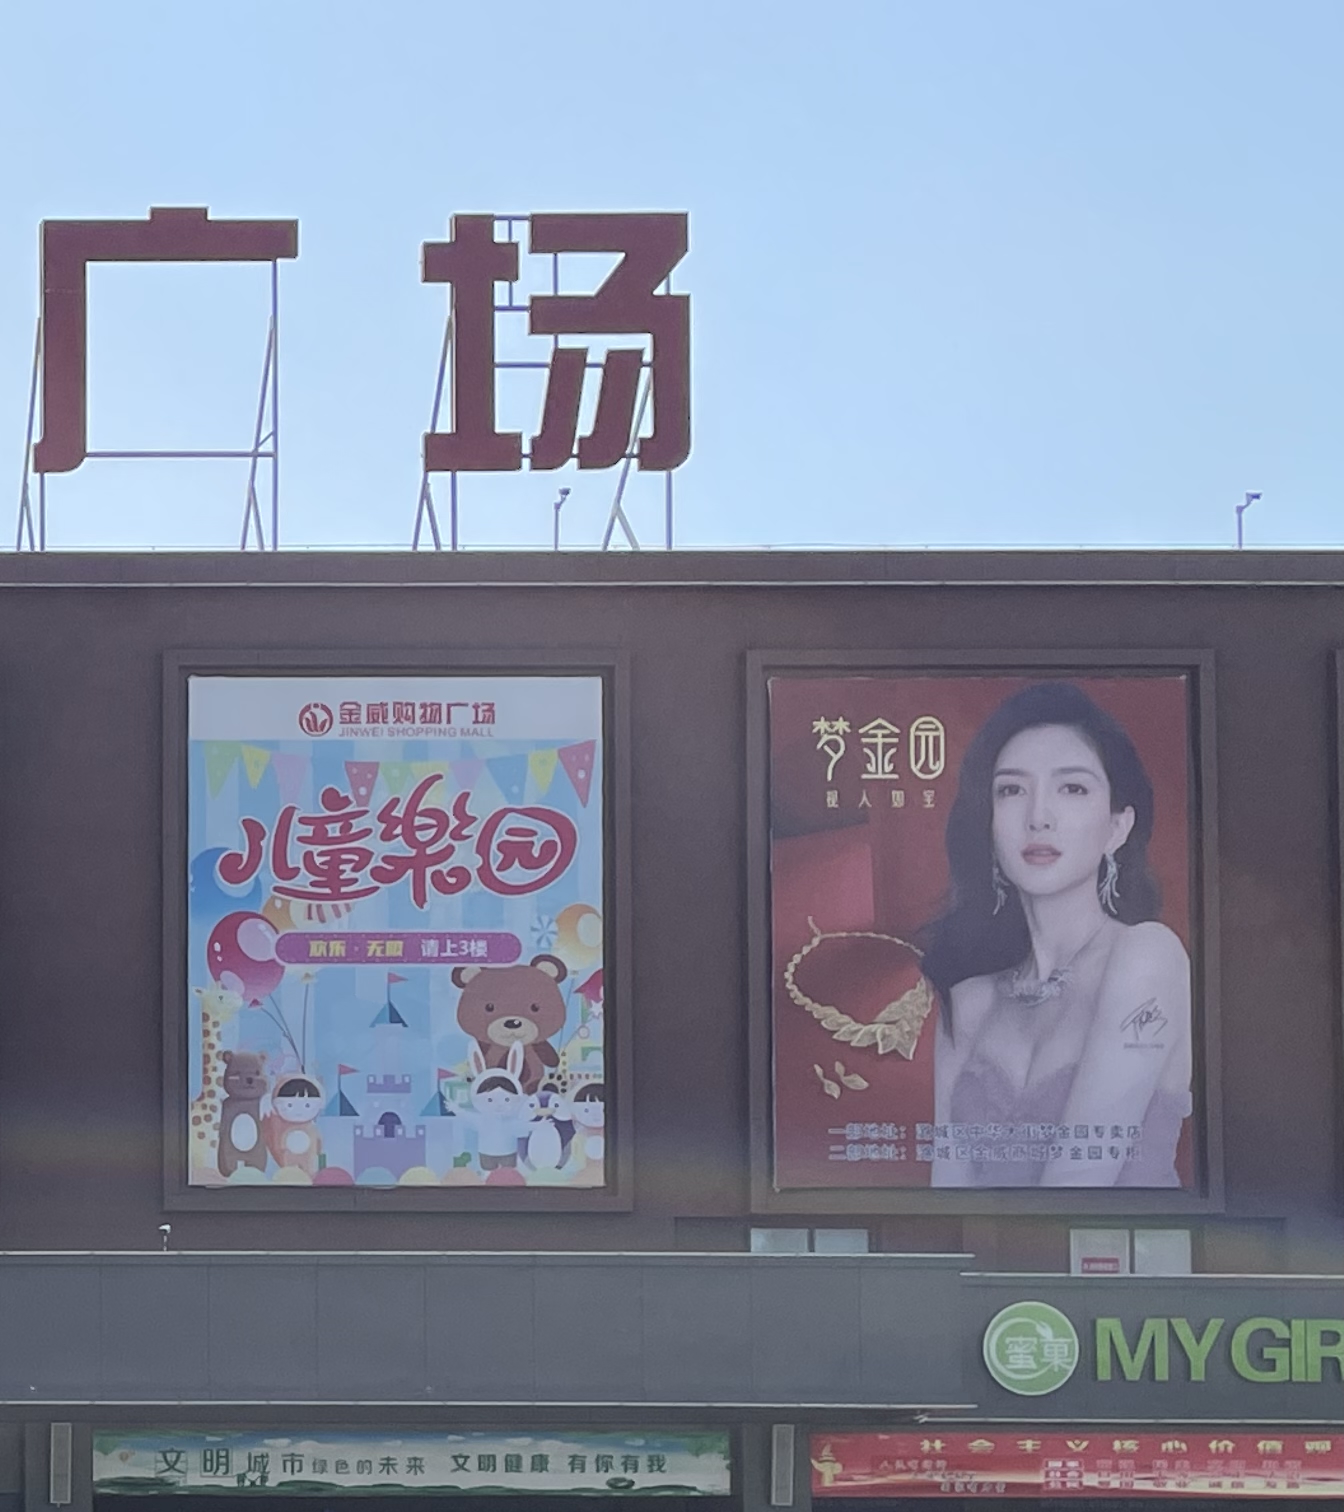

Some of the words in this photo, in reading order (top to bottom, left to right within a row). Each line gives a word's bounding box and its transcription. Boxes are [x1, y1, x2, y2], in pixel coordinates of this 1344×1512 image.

[339, 701, 496, 725] 金威购物广场
[339, 727, 384, 738] JINWEI
[387, 727, 458, 738] SHOPPING
[460, 727, 494, 738] MALL
[812, 716, 945, 781] 梦金园
[420, 939, 488, 958] 请上3楼
[450, 1452, 551, 1475] 文明健康
[567, 1452, 668, 1475] 有你有我
